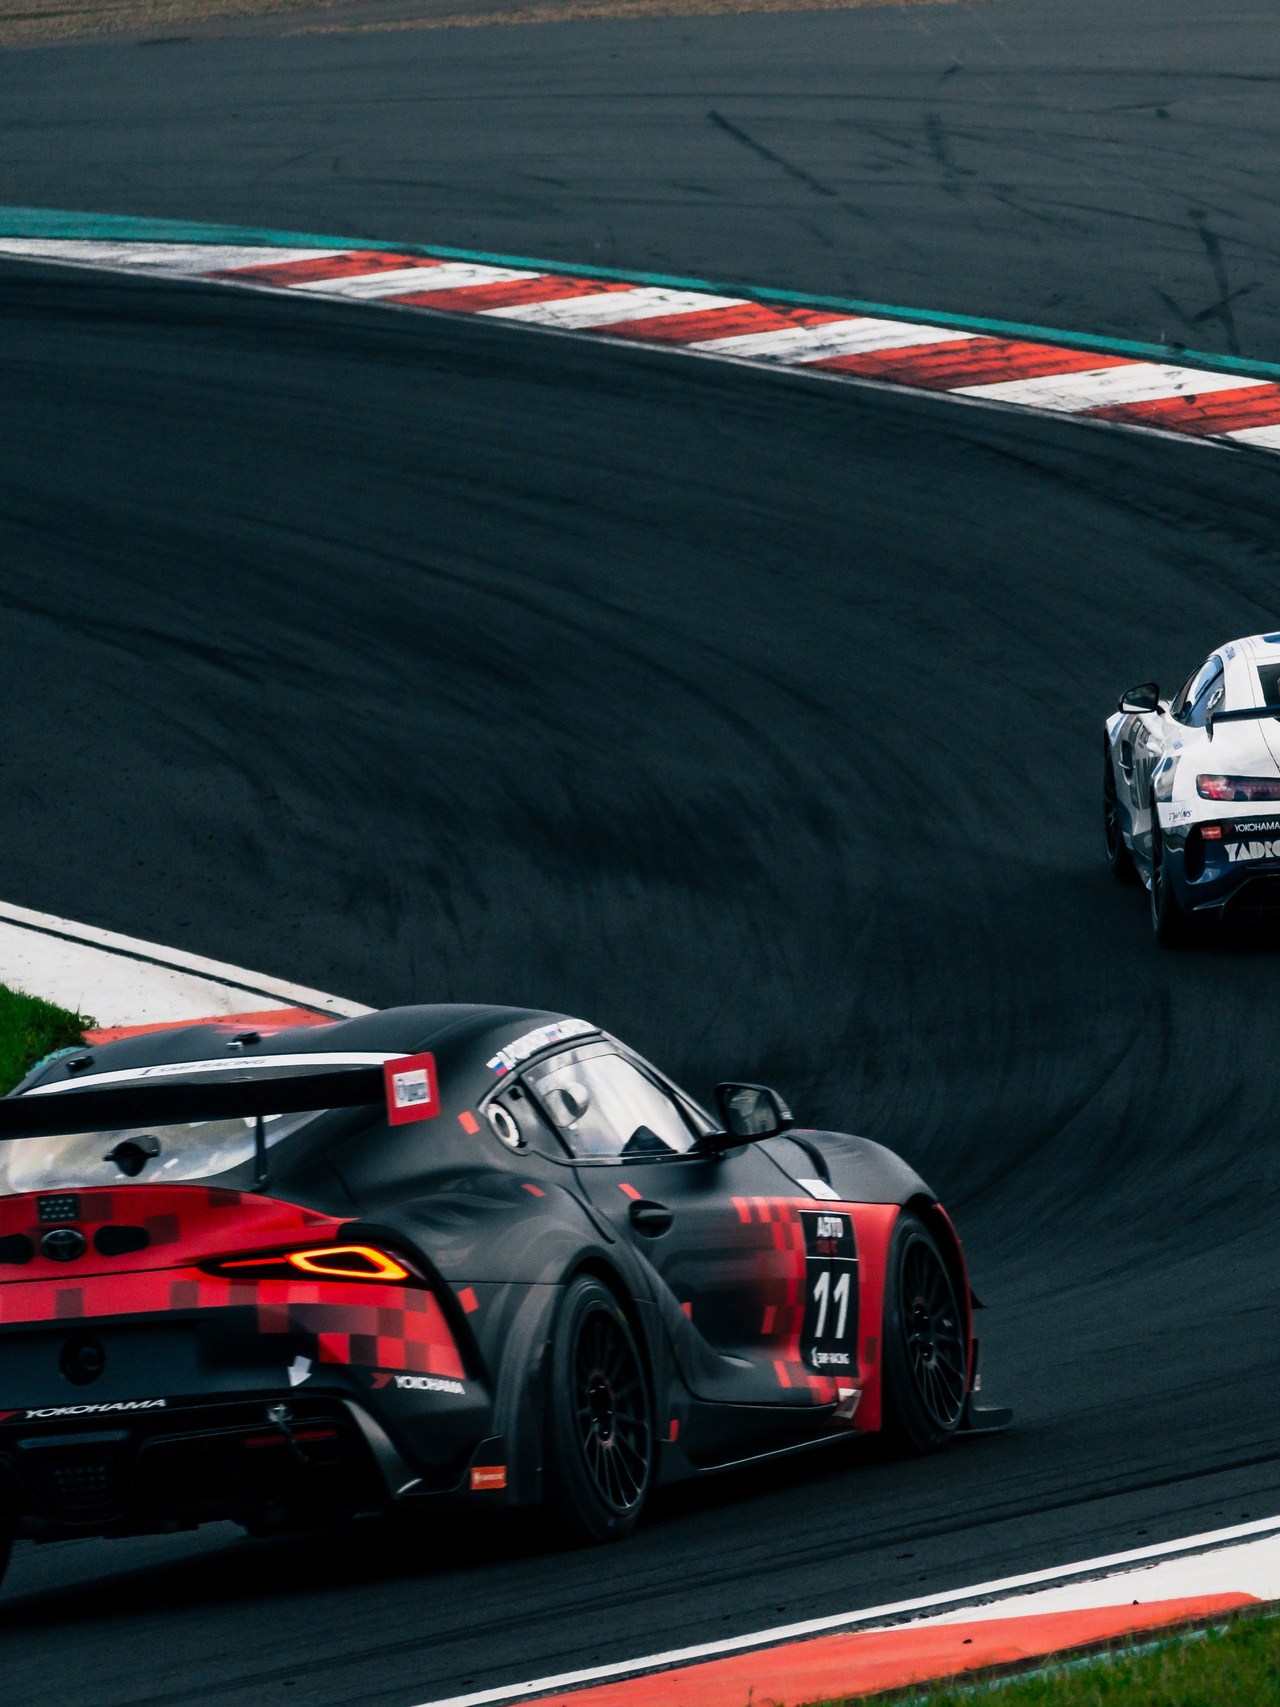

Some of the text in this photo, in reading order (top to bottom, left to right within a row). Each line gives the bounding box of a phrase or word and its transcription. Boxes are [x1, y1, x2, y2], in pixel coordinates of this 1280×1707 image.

[1234, 821, 1280, 832] YOKOHAMA
[813, 1271, 850, 1339] 11
[25, 1398, 167, 1419] YOKOHAMA
